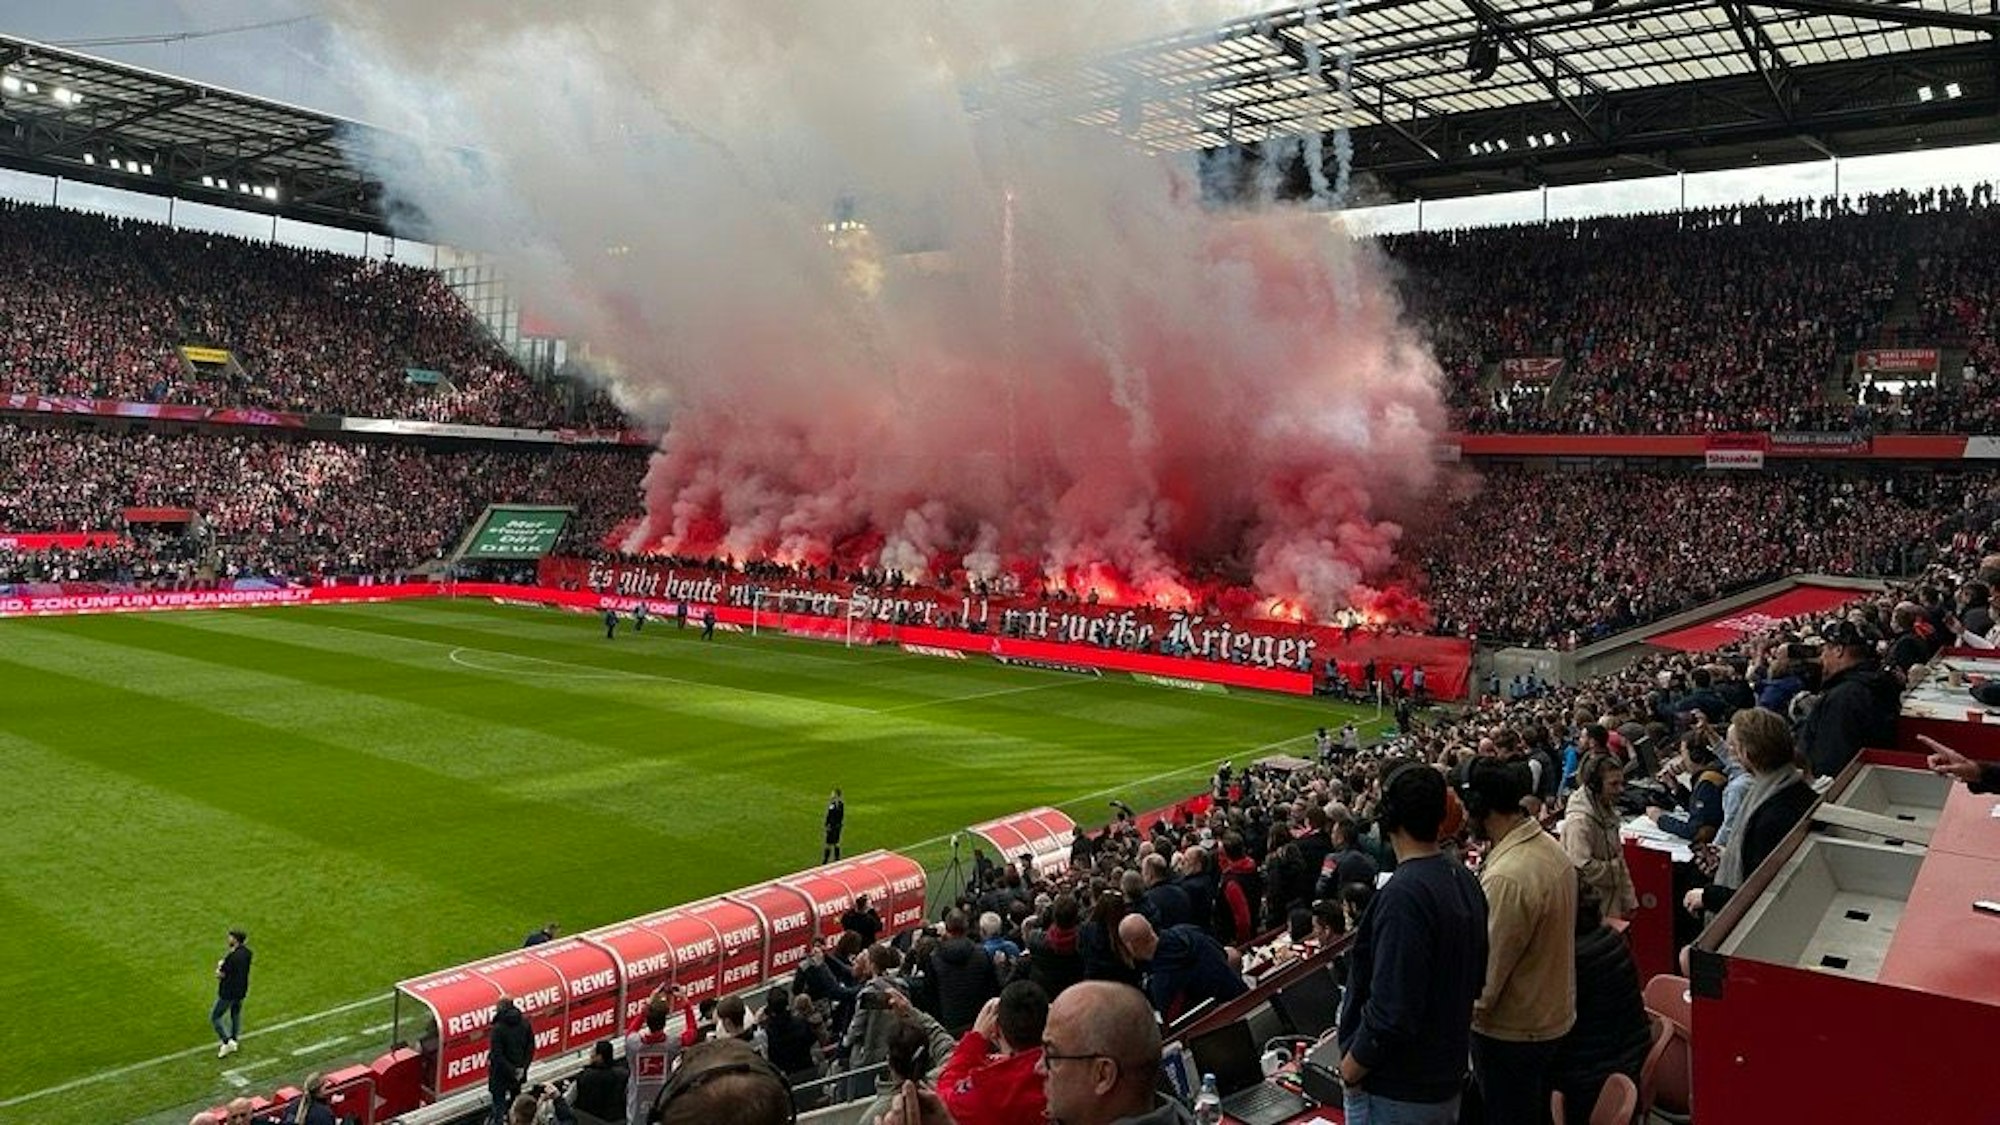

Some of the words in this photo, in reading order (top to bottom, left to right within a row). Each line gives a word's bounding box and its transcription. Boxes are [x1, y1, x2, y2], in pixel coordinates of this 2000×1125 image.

[480, 544, 542, 553] DEVK
[663, 569, 722, 604] heute
[1168, 612, 1318, 667] Krieger
[892, 873, 923, 895] REWE
[818, 895, 851, 918] REWE
[893, 905, 921, 927] REWE
[773, 911, 808, 934] REWE
[722, 924, 761, 949] REWE
[676, 938, 717, 964] REWE
[772, 944, 808, 968] REWE
[626, 952, 670, 980] REWE
[723, 960, 760, 985] REWE
[570, 968, 617, 997] REWE
[512, 985, 562, 1014] REWE
[570, 1007, 615, 1037] REWE
[533, 1026, 561, 1050] WE
[447, 1049, 491, 1080] REW
